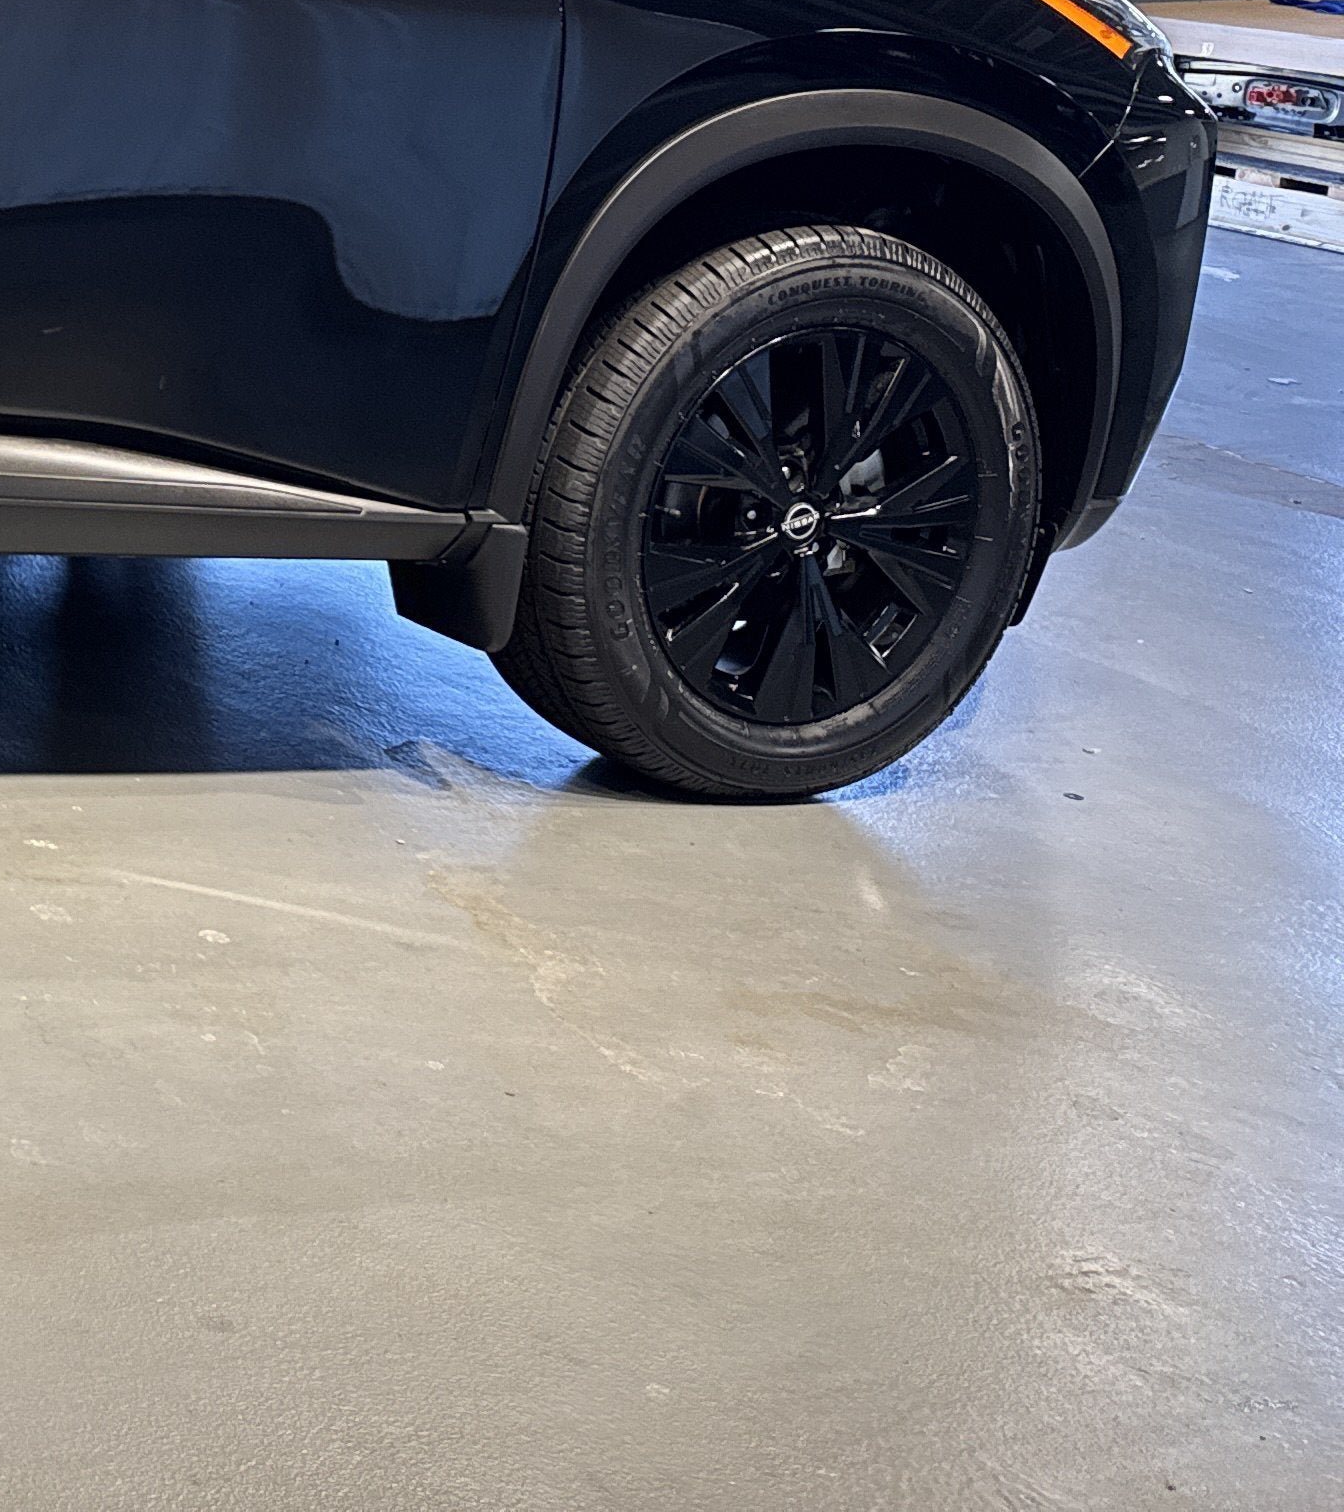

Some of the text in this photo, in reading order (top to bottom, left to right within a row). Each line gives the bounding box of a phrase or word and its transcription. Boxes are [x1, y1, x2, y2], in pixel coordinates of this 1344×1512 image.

[767, 275, 928, 306] CONQUEST TOURING
[603, 432, 646, 641] GOODYEAR
[781, 511, 820, 532] NISSAN
